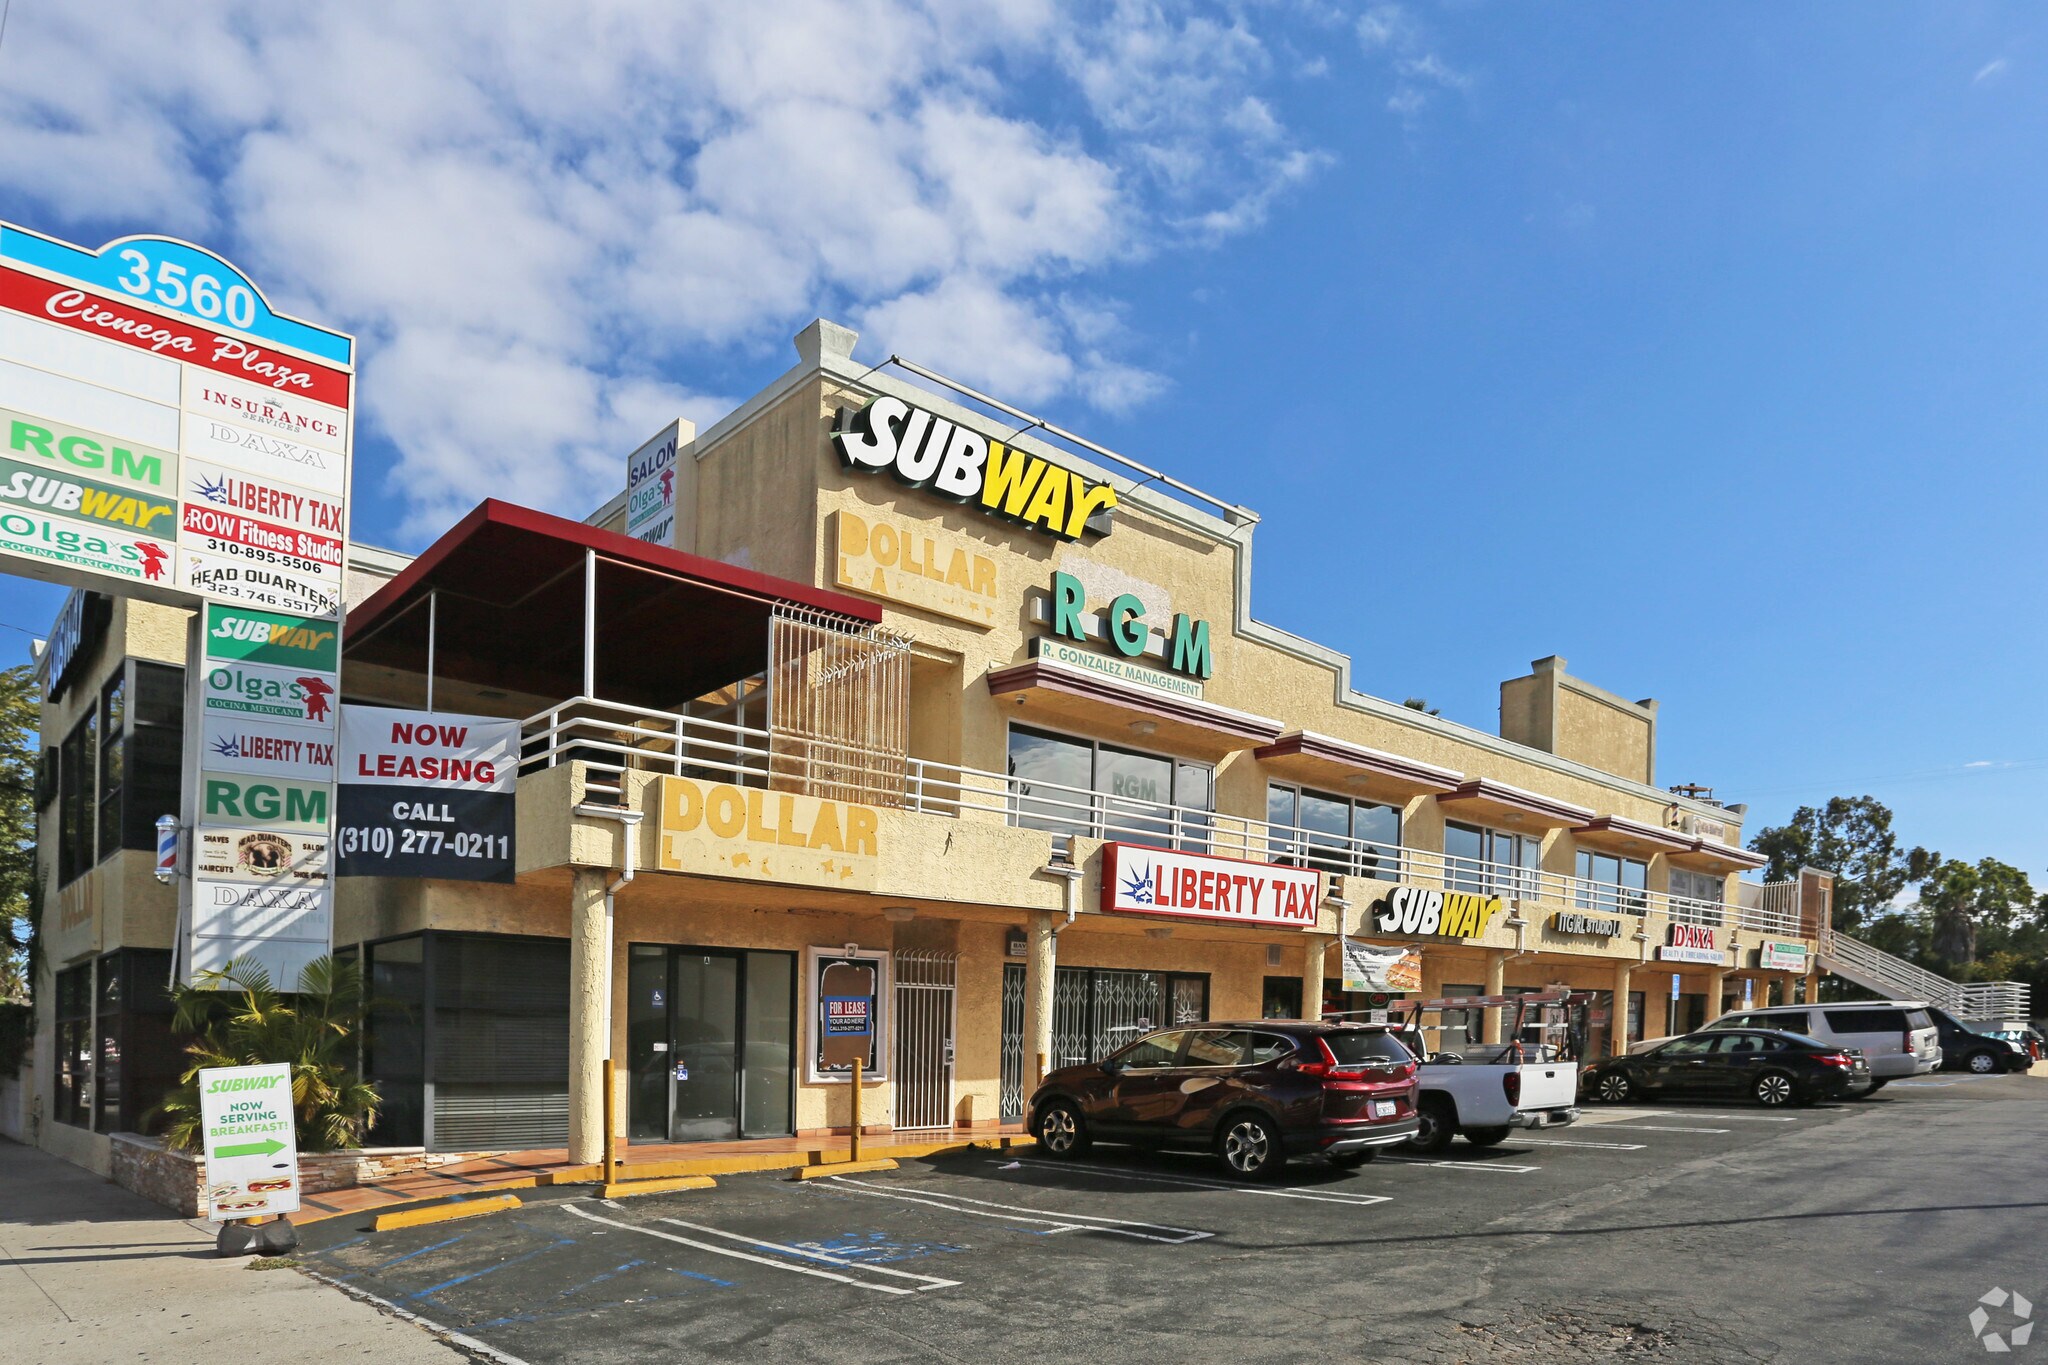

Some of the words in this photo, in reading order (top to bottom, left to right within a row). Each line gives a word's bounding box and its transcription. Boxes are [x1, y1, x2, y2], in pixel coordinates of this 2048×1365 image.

[117, 248, 256, 329] 3560
[45, 289, 198, 353] Cienega
[212, 335, 314, 389] Plaza
[203, 389, 338, 437] INSURANCE
[242, 411, 301, 433] SERVICES
[10, 420, 162, 486] RGM
[210, 423, 326, 469] DAXA
[630, 437, 677, 488] SALON
[840, 396, 1118, 539] SUBWAY
[0, 471, 173, 529] SUBWAY
[228, 478, 304, 522] LIBERTY
[309, 500, 342, 533] TAX
[207, 539, 322, 573] 310-895-5506
[239, 519, 294, 552] Fitness
[297, 533, 342, 564] Studio
[839, 509, 998, 600] DOLLAR
[0, 541, 58, 559] COCINA
[62, 554, 137, 576] MEXICANA
[191, 568, 238, 586] HEAD
[245, 569, 338, 616] QUARTERS
[207, 581, 318, 613] 323.746.5517
[211, 617, 334, 650] SUBWAY
[1043, 642, 1054, 658] R.
[1058, 648, 1121, 676] GONZALEZ
[1125, 667, 1200, 697] MANAGEMENT
[209, 699, 247, 711] COCINA
[250, 704, 301, 717] MEXICANA
[240, 735, 301, 764] LIBERTY
[306, 742, 334, 766] TAX
[391, 722, 468, 748] NOW
[358, 754, 495, 784] LEASING
[205, 780, 327, 824] RGM
[1112, 771, 1157, 801] RGM
[393, 801, 455, 823] CALL
[663, 776, 878, 857] DOLLAR
[203, 835, 230, 844] SHAVES
[257, 833, 292, 852] QUARTERS
[303, 843, 325, 851] SALON
[337, 827, 394, 859] (310)
[400, 828, 509, 860] 277-0211
[198, 864, 234, 873] HAIRCUTS
[213, 886, 317, 911] DAXA
[1154, 864, 1265, 915] LIBERTY
[1271, 879, 1315, 920] TAX
[1379, 886, 1503, 939] SUBWAY
[1586, 918, 1612, 936] STUDIO
[1662, 948, 1679, 958] BEAUTY
[1673, 924, 1715, 950] DAXA
[829, 1001, 842, 1014] FOR
[845, 1001, 866, 1014] LEASE
[206, 1074, 285, 1094] SUBWAY
[220, 1110, 277, 1124] SERVING
[230, 1101, 263, 1112] NOW
[210, 1121, 288, 1137] BREAKFAST!
